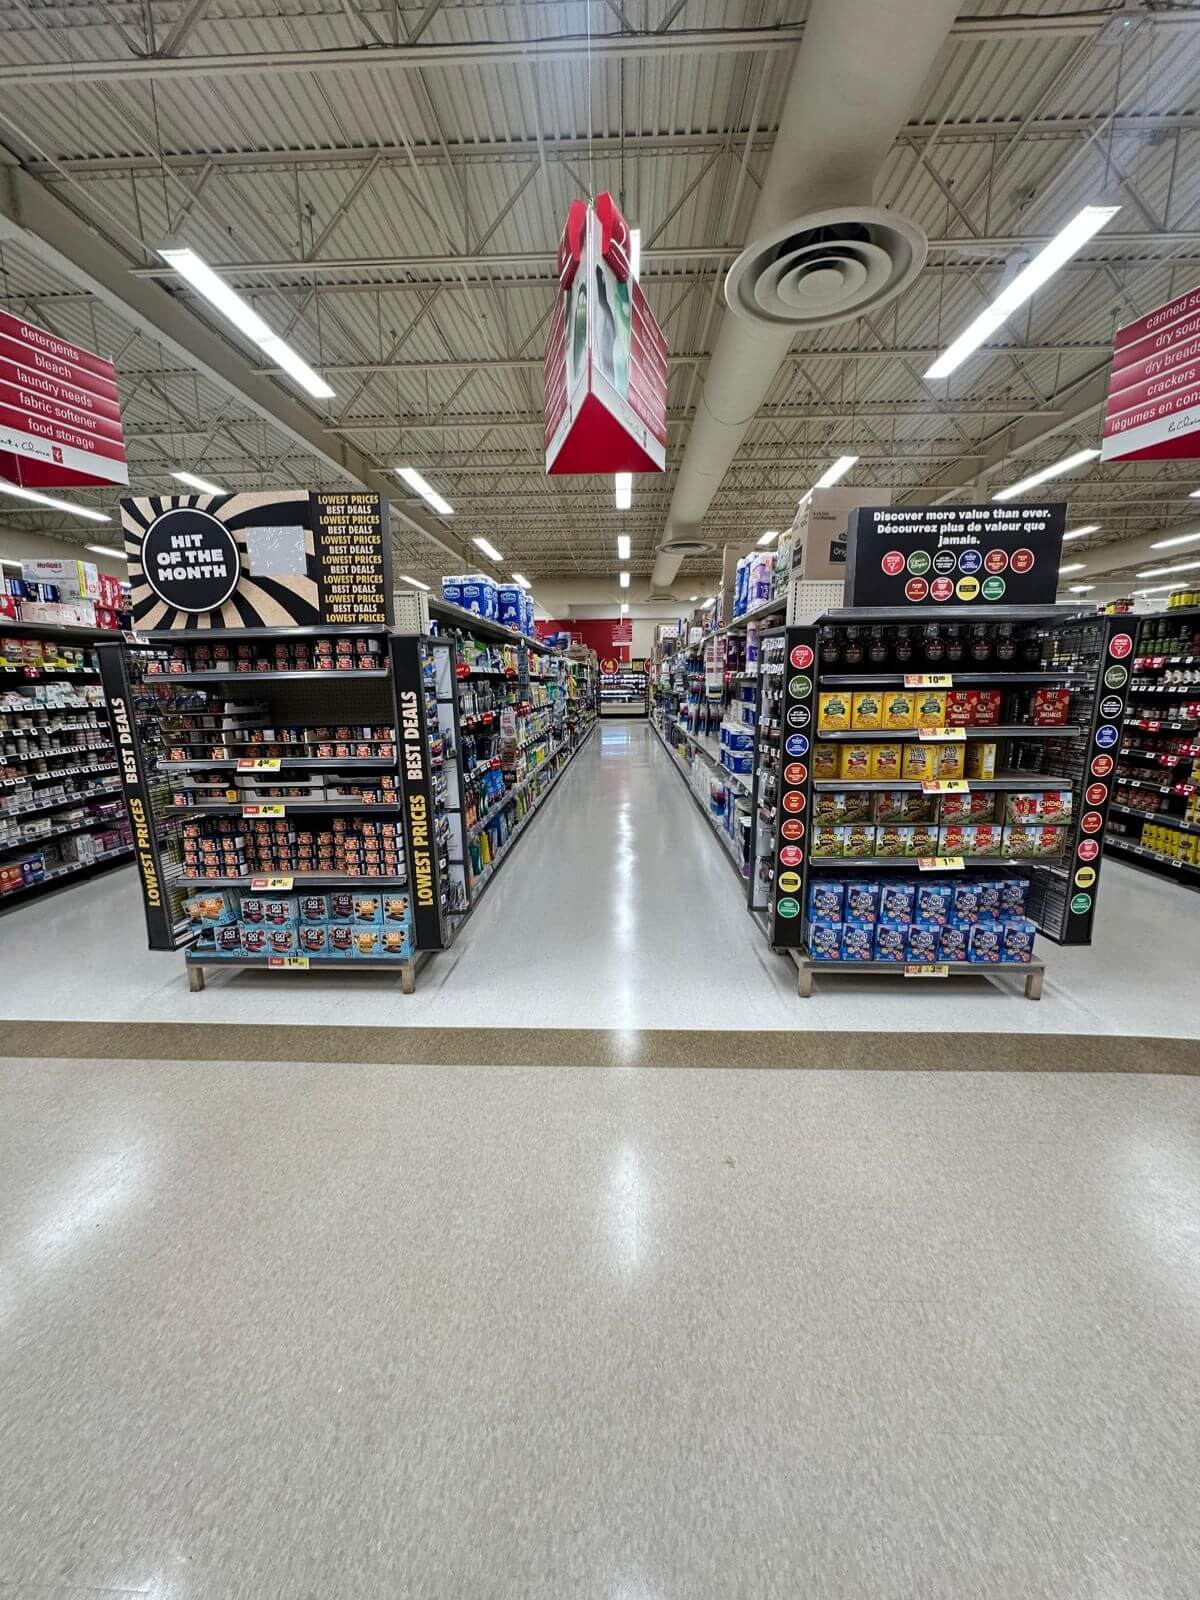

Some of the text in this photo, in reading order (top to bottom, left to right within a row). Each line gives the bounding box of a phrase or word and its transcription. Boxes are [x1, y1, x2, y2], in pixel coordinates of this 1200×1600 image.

[1146, 302, 1186, 329] canned
[21, 326, 79, 360] detergents
[1156, 331, 1173, 347] dry
[35, 354, 72, 379] bleach
[1145, 359, 1162, 375] dry
[17, 368, 93, 407] laundry needs
[1147, 368, 1195, 397] crackers
[19, 392, 96, 429] fabric softener
[1111, 407, 1156, 432] légumes
[1158, 401, 1172, 414] en
[28, 418, 95, 449] food storage
[318, 495, 378, 505] LOWEST PRICES
[326, 505, 371, 514] BEST DEALS
[873, 509, 1051, 521] Discover more value than ever.
[320, 515, 379, 524] LOWEST PRICES
[328, 525, 372, 534] BEST DEALS
[877, 522, 1045, 534] Découvrez plus de valeur que
[170, 534, 203, 549] HIT
[321, 535, 380, 545] LOWEST PRICES
[937, 535, 980, 547] jamais.
[157, 548, 224, 565] OF THE
[329, 545, 373, 555] BEST DEALS
[322, 555, 382, 565] LOWEST PRICES
[158, 565, 227, 582] MONTH
[330, 565, 375, 575] BEST DEALS
[324, 575, 383, 584] LOWEST PRICES
[332, 584, 376, 594] BEST DEALS
[325, 594, 384, 604] LOWEST PRICES
[333, 604, 377, 613] BEST DEALS
[326, 613, 385, 623] LOWEST PRICES
[1047, 692, 1058, 700] RITZ
[112, 698, 138, 784] BEST DEALS
[401, 691, 422, 780] BEST DEALS
[130, 798, 160, 907] LOWEST PRICES
[410, 794, 433, 906] LOWEST PRICES
